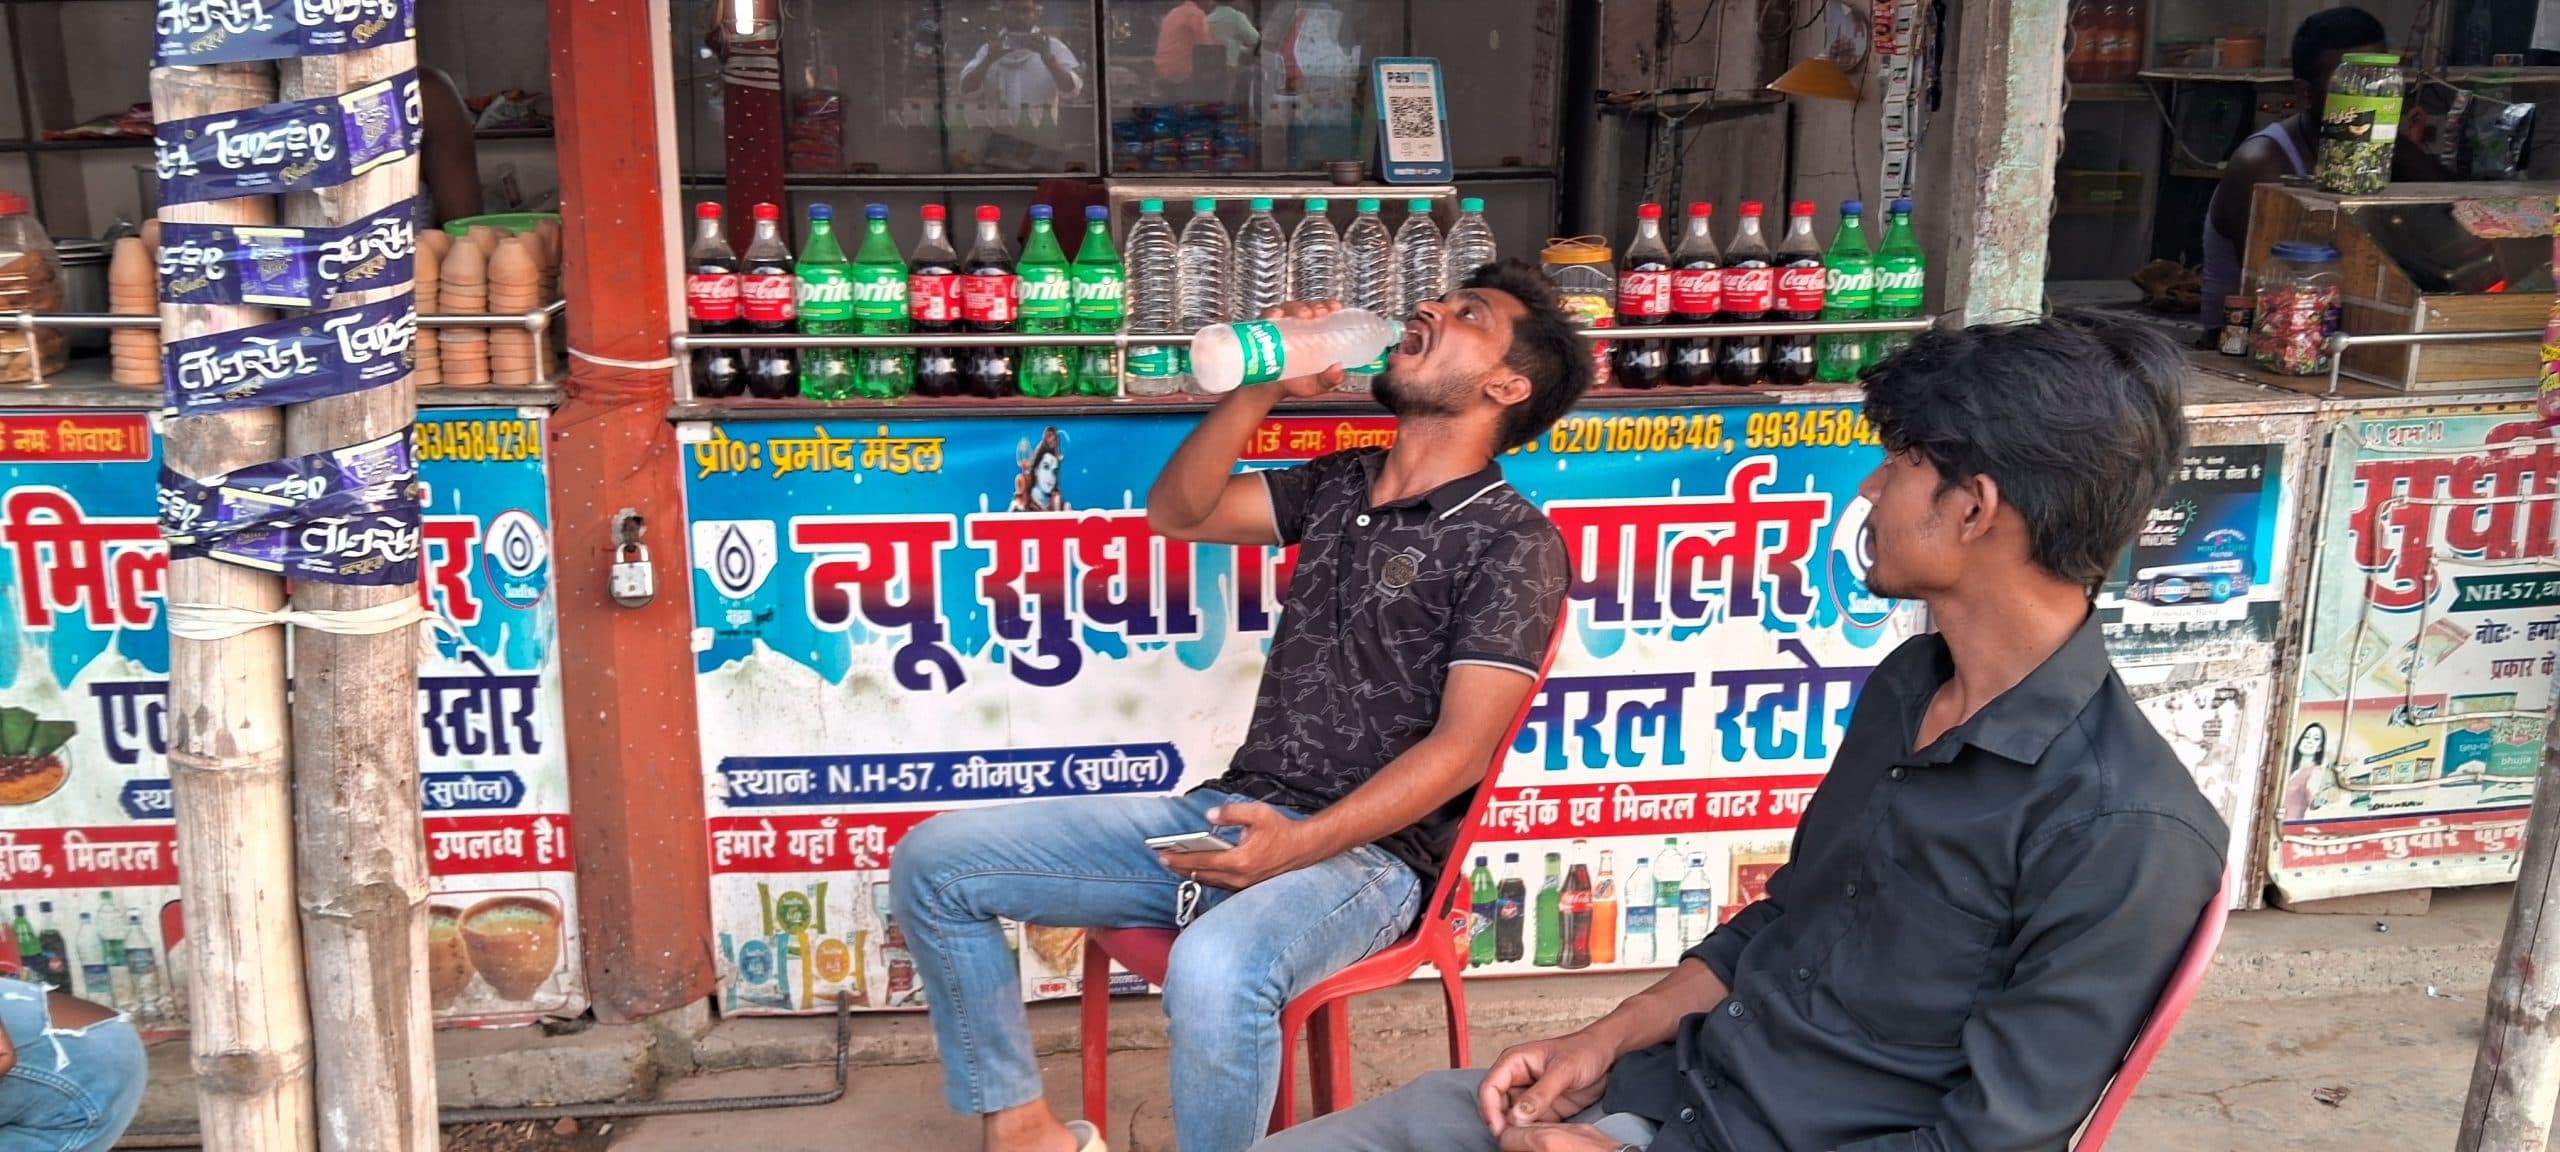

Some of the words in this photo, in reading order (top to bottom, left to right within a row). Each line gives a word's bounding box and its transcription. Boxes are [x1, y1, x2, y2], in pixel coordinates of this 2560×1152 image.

[415, 420, 542, 462] 934584234
[1745, 408, 1882, 449] 9934584
[766, 424, 855, 480] प्रमोद
[859, 424, 946, 475] मंडल
[1513, 671, 1697, 773] नरल
[951, 755, 1055, 794] भीमपुर
[1568, 786, 1606, 827] एवं
[1612, 783, 1698, 824] मिनरल
[1706, 788, 1758, 820] वाटर
[63, 829, 160, 872] मिनरल
[712, 818, 777, 866] हमारे
